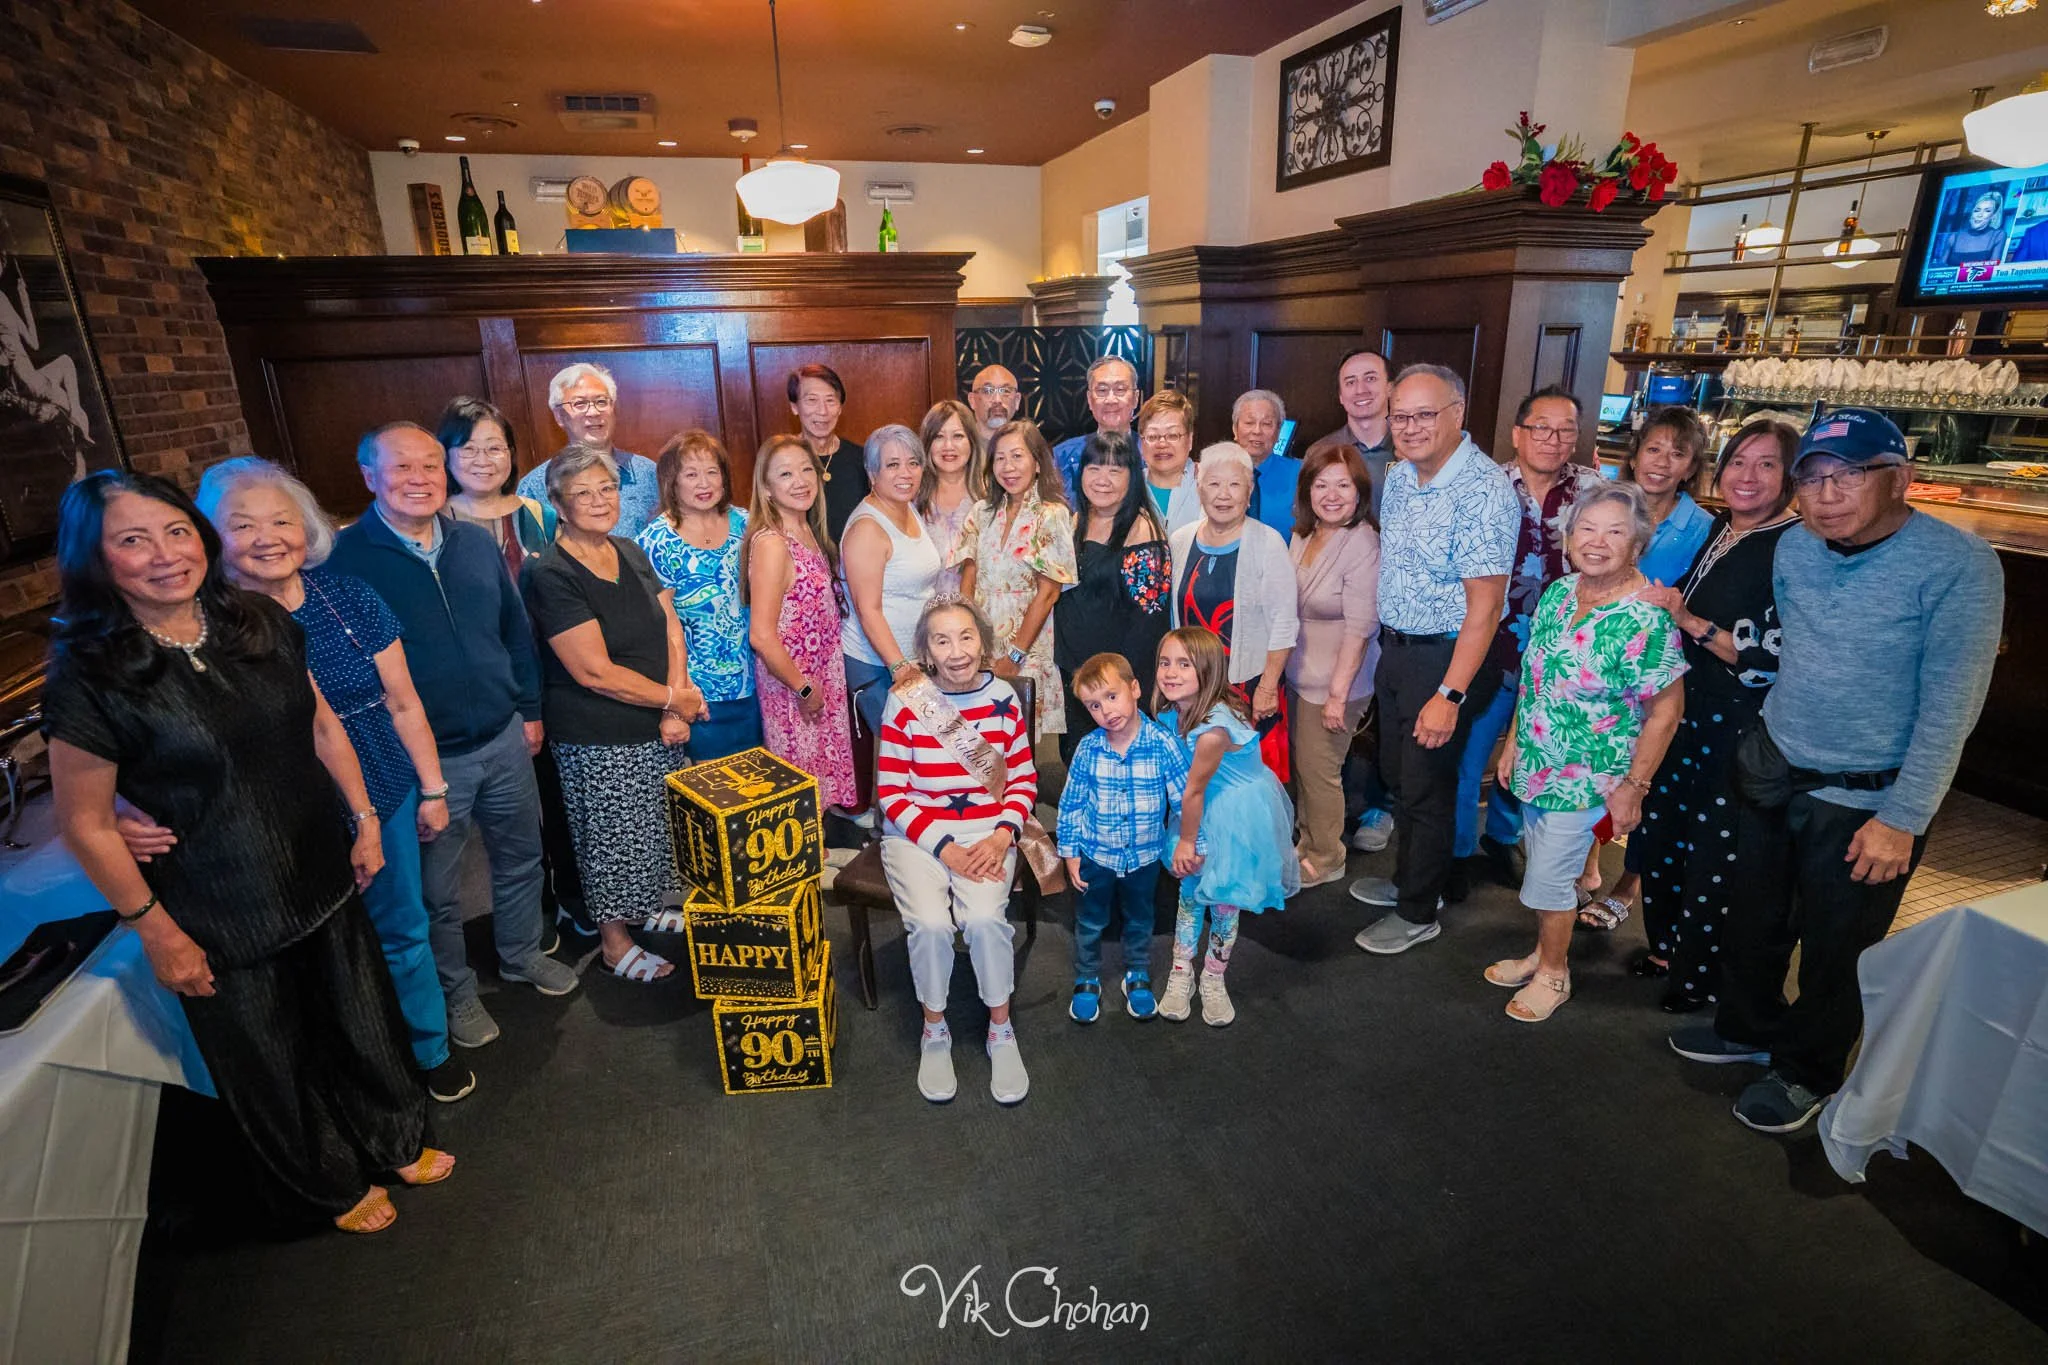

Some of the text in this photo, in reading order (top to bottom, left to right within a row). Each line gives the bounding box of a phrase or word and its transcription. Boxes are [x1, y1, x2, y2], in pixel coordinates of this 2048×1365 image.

[745, 798, 800, 829] Happy
[745, 818, 804, 873] 90
[747, 859, 808, 895] Birthday
[695, 942, 790, 970] HAPPY
[740, 1013, 800, 1031] Happy
[740, 1030, 804, 1069] 90
[742, 1067, 809, 1087] Birthday
